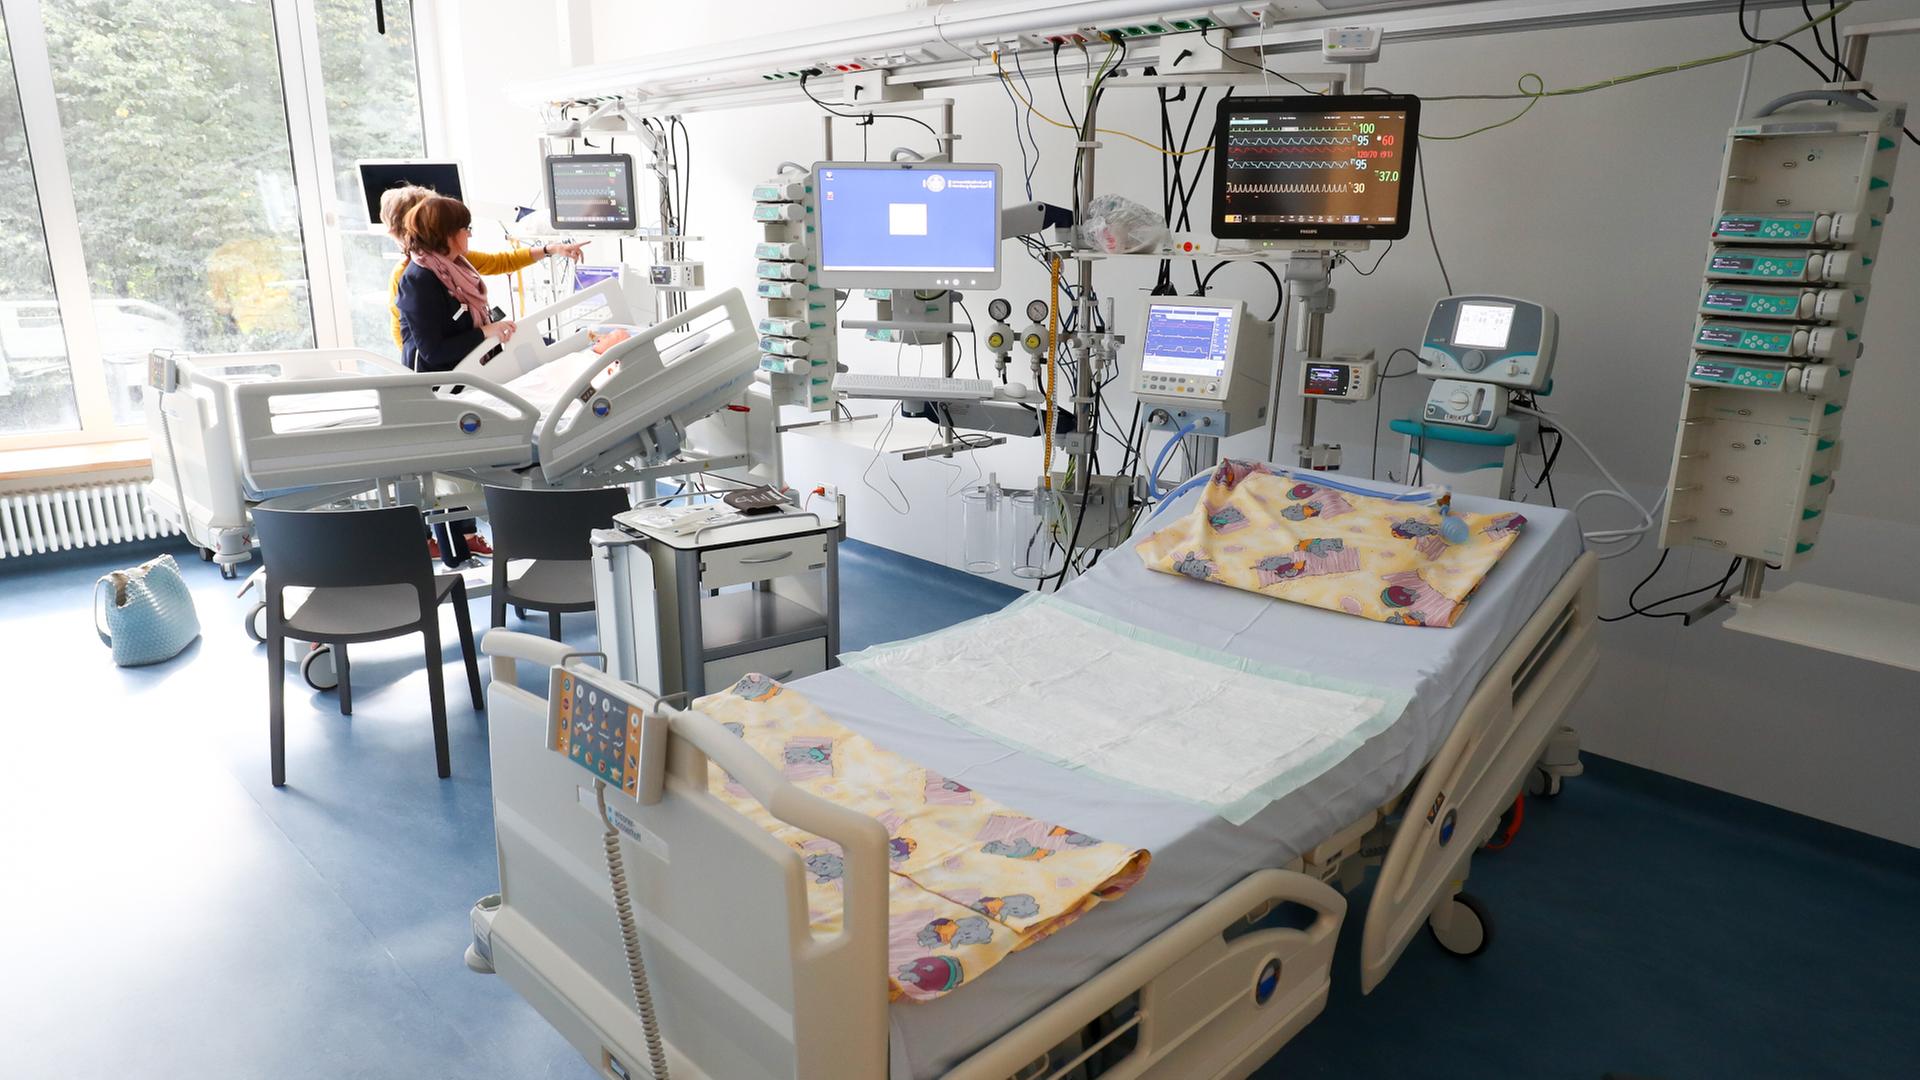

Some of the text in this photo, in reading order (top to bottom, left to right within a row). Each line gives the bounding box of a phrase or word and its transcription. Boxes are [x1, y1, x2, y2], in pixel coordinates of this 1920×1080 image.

[1359, 123, 1375, 134] 100
[1357, 135, 1369, 146] 95
[1382, 135, 1394, 146] 60
[1355, 159, 1367, 170] 95
[1379, 171, 1399, 182] 37.0
[1353, 183, 1365, 193] 30
